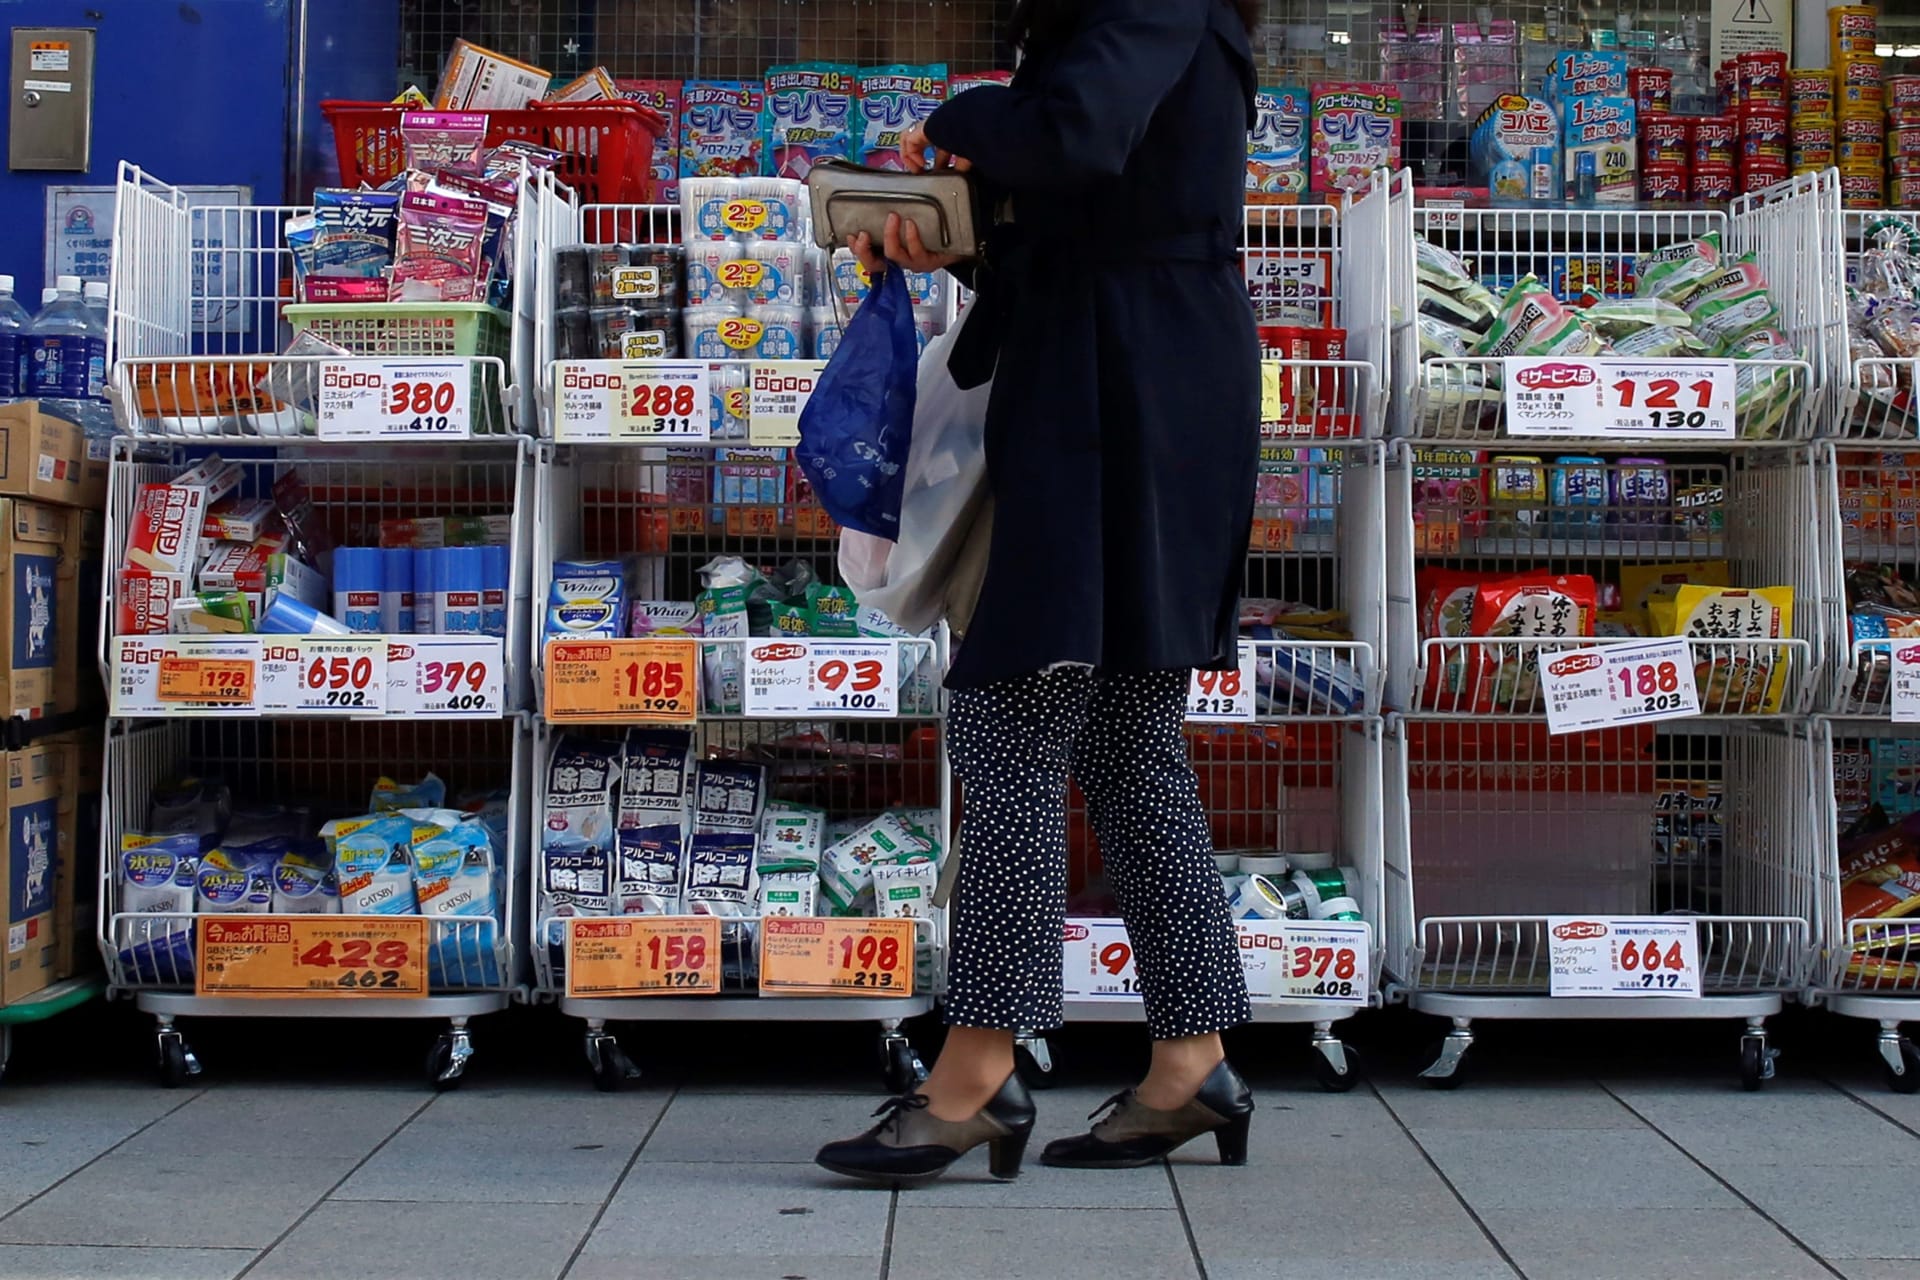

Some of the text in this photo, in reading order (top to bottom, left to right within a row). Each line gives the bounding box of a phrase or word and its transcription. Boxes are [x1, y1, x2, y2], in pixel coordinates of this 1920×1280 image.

[821, 72, 840, 90] 48
[861, 76, 912, 94] 引き出し防虫
[913, 77, 932, 93] 48
[739, 90, 751, 106] 3
[1281, 95, 1294, 112] 3
[1374, 94, 1387, 112] 3
[771, 91, 852, 124] ピレパラ
[1319, 113, 1394, 143] ピレパラ
[1502, 113, 1551, 133] コバエ
[409, 143, 476, 162] 三次元
[698, 143, 744, 156] アロマソープ
[1605, 151, 1627, 167] 240
[412, 197, 436, 208] 日本製
[320, 206, 394, 228] 三次元
[407, 225, 475, 249] 三次元
[324, 373, 381, 389] おすすめ
[564, 374, 622, 390] おすすめ
[754, 376, 812, 393] おすすめ
[1528, 368, 1594, 385] サービス品
[389, 381, 463, 415] 380 円
[630, 384, 703, 417] 288 円
[1548, 392, 1565, 402] 各種
[1611, 378, 1730, 410] 121 円
[324, 401, 354, 410] マスク各種
[409, 416, 448, 431] 410
[652, 418, 690, 433] 311
[1647, 410, 1706, 428] 130
[1414, 450, 1472, 464] 1年間有効
[560, 581, 609, 595] White
[644, 604, 690, 619] White
[760, 646, 805, 657] サービス品
[306, 655, 380, 690] 650 円
[750, 668, 785, 676] キレイキレイ
[1556, 655, 1601, 673] サービス品
[206, 671, 246, 688] 178
[422, 660, 498, 694] 379 円
[624, 661, 684, 698] 185
[817, 659, 883, 692] 93
[1618, 661, 1691, 698] 188 円
[325, 690, 366, 706] 702
[446, 694, 486, 710] 409
[642, 698, 679, 711] 199
[839, 694, 876, 708] 100
[1196, 698, 1234, 713] 213
[1644, 693, 1681, 713] 203
[629, 755, 681, 768] アルコール
[552, 766, 606, 792] 除菌
[626, 767, 680, 794] 除菌
[703, 773, 756, 788] アルコール
[548, 794, 606, 805] ウエットタオル
[623, 797, 680, 807] ウエットタオル
[700, 785, 756, 812] 除菌
[549, 857, 604, 867] アルコール
[623, 846, 676, 862] アルコール
[695, 850, 748, 864] アルコール
[623, 857, 675, 882] 除菌
[692, 862, 748, 887] 除菌
[876, 864, 930, 880] キレイキレイ
[549, 868, 605, 893] 除菌
[359, 885, 395, 908] GATSBY
[438, 889, 473, 914] GATSBY
[207, 924, 290, 943] 今月のお買得品
[1561, 924, 1606, 937] サービス品
[299, 939, 418, 969] 428 円
[647, 934, 706, 970] 158
[839, 934, 899, 972] 198
[1099, 942, 1140, 976] 9
[1552, 946, 1597, 955] フルーツグラノーラ
[1620, 938, 1685, 972] 664
[1291, 945, 1364, 981] 378 円
[1554, 956, 1578, 965] フルグラ
[337, 970, 400, 988] 462
[663, 972, 700, 986] 170
[853, 971, 893, 986] 213
[1641, 973, 1680, 988] 717
[1312, 980, 1353, 996] 408
